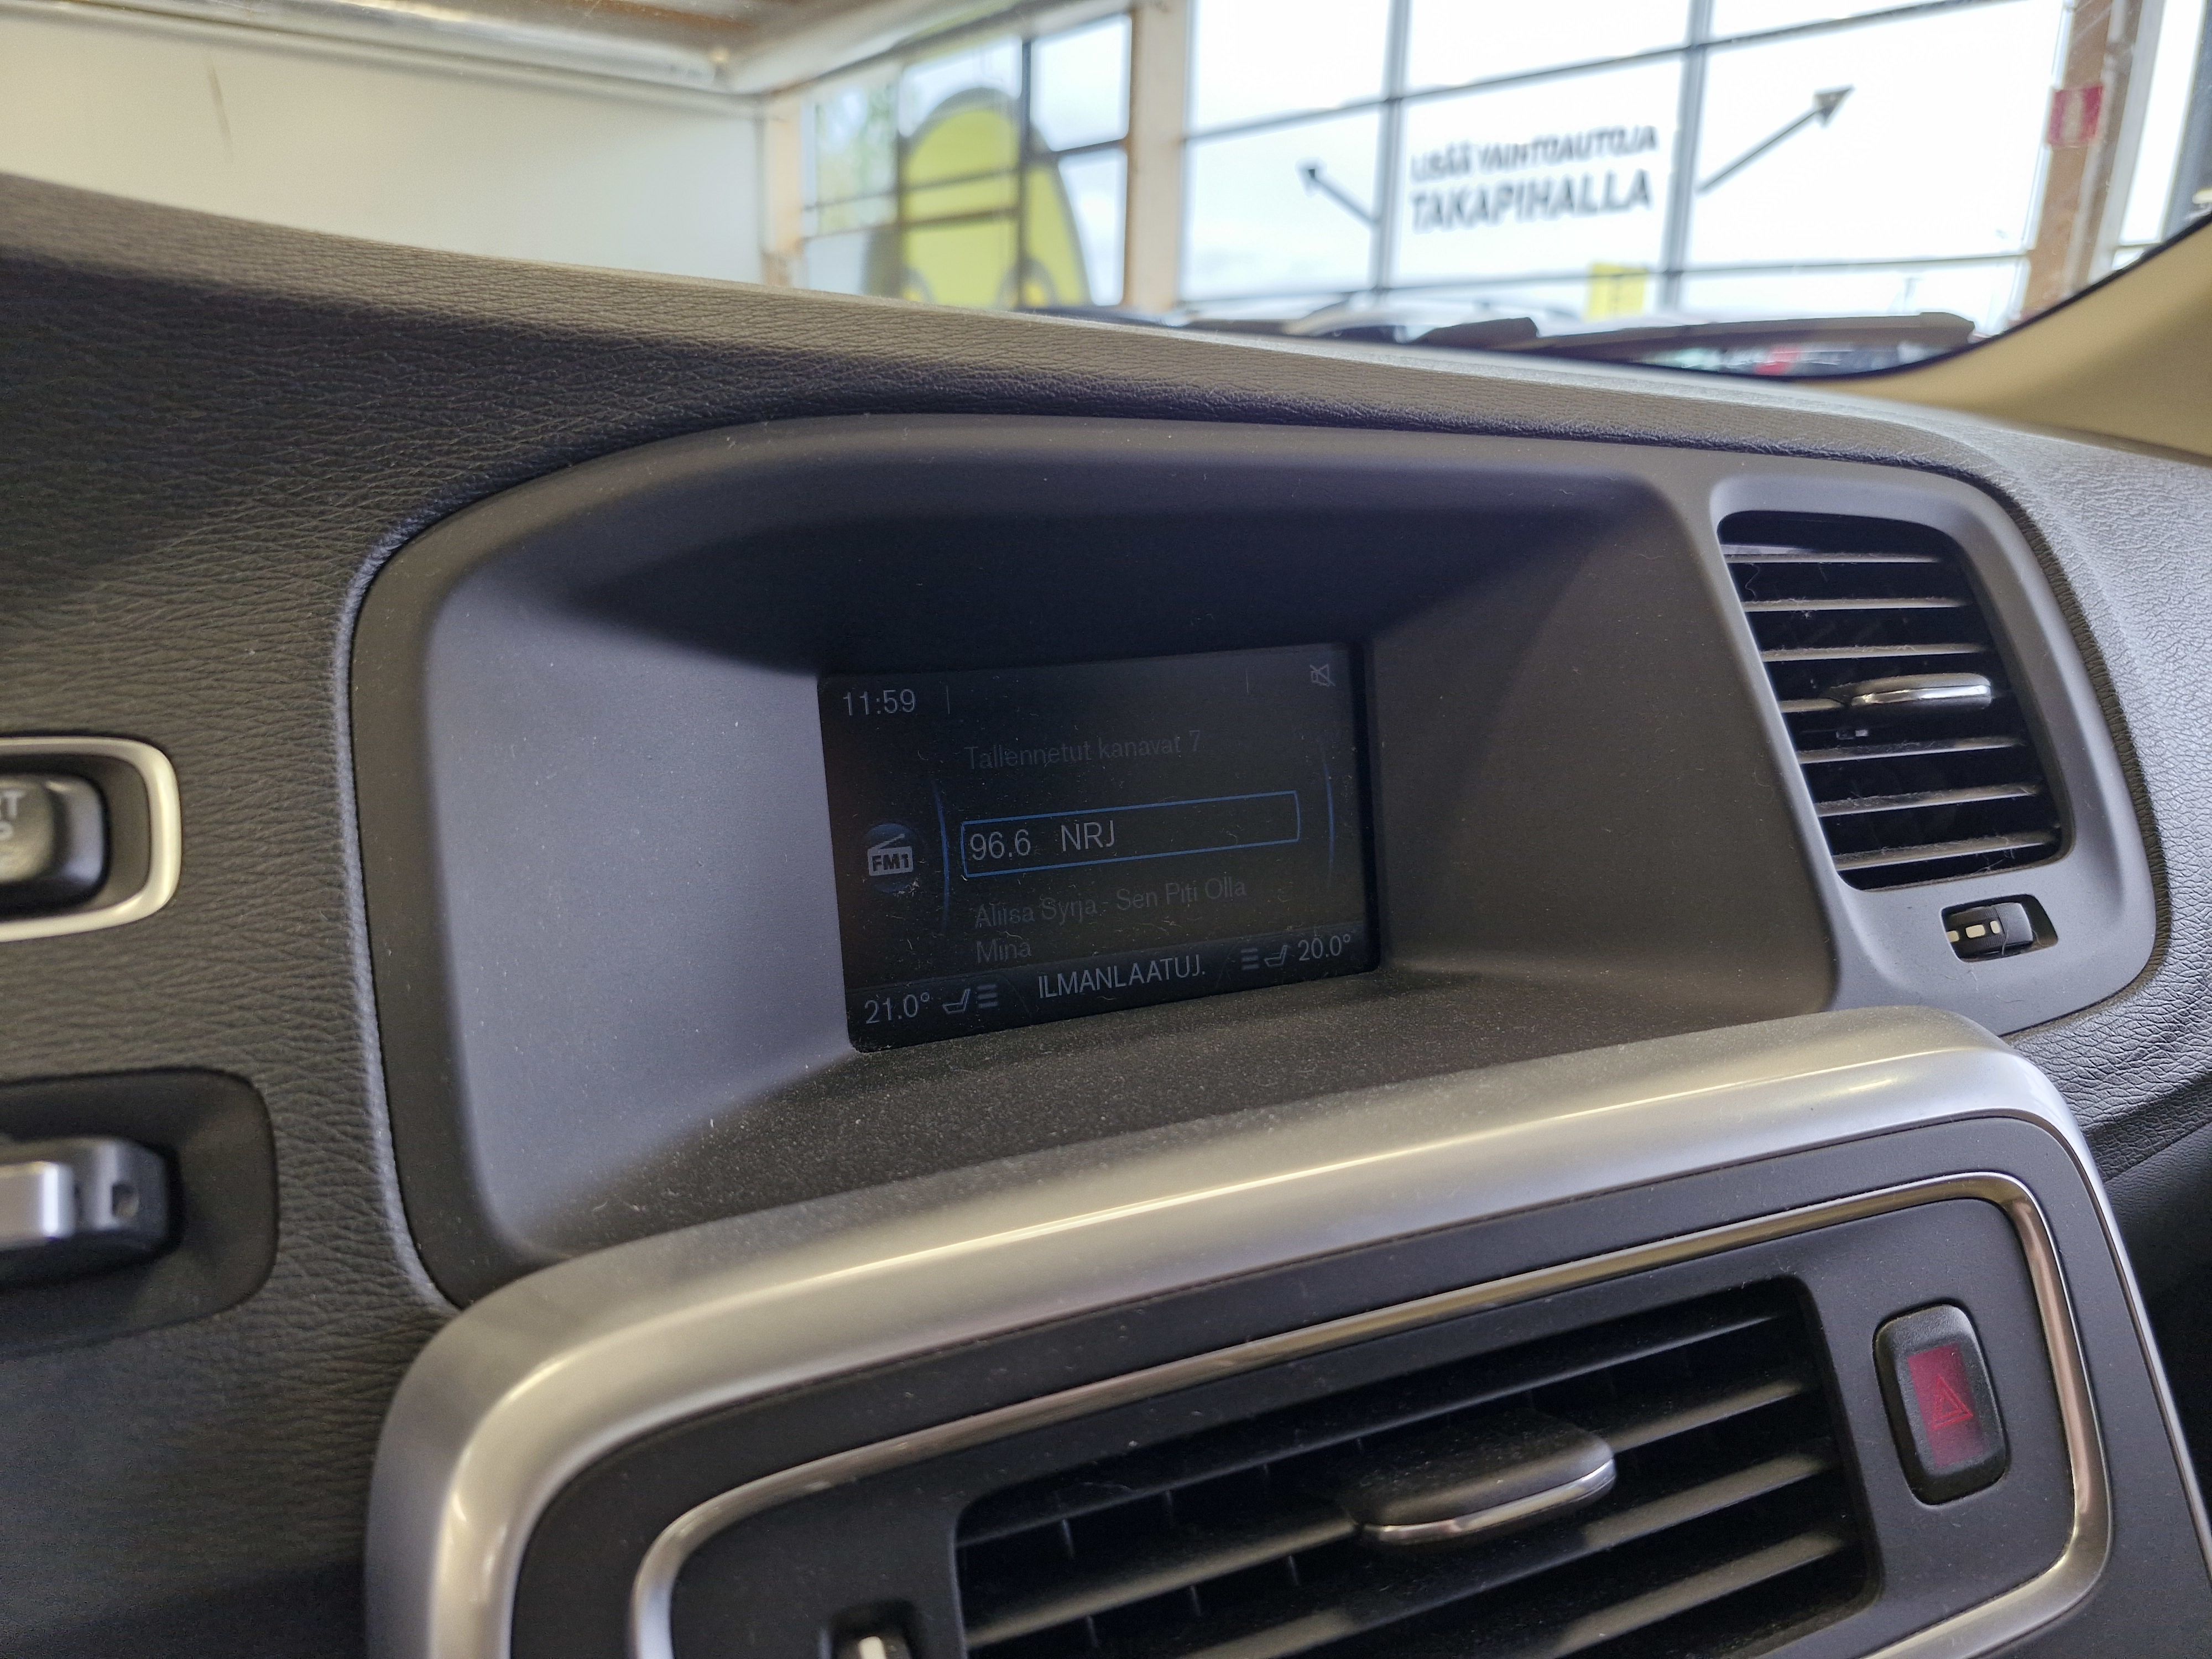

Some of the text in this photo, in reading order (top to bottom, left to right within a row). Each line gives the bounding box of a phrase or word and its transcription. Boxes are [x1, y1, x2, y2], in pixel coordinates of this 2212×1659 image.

[1410, 168, 1654, 234] TAKAPIHALLA
[843, 689, 916, 716] 11:59
[964, 729, 1201, 769] Tallennetut kanavat 7
[969, 820, 1115, 860] 96.6 NRJ
[872, 852, 910, 872] FM1
[1116, 888, 1158, 911] Sen
[1165, 880, 1198, 905] Piti
[1204, 875, 1247, 900] Olla
[1298, 933, 1350, 962] 20.0°
[1038, 954, 1206, 999] ILMANLAATUJ.
[864, 992, 931, 1024] 21.0°
